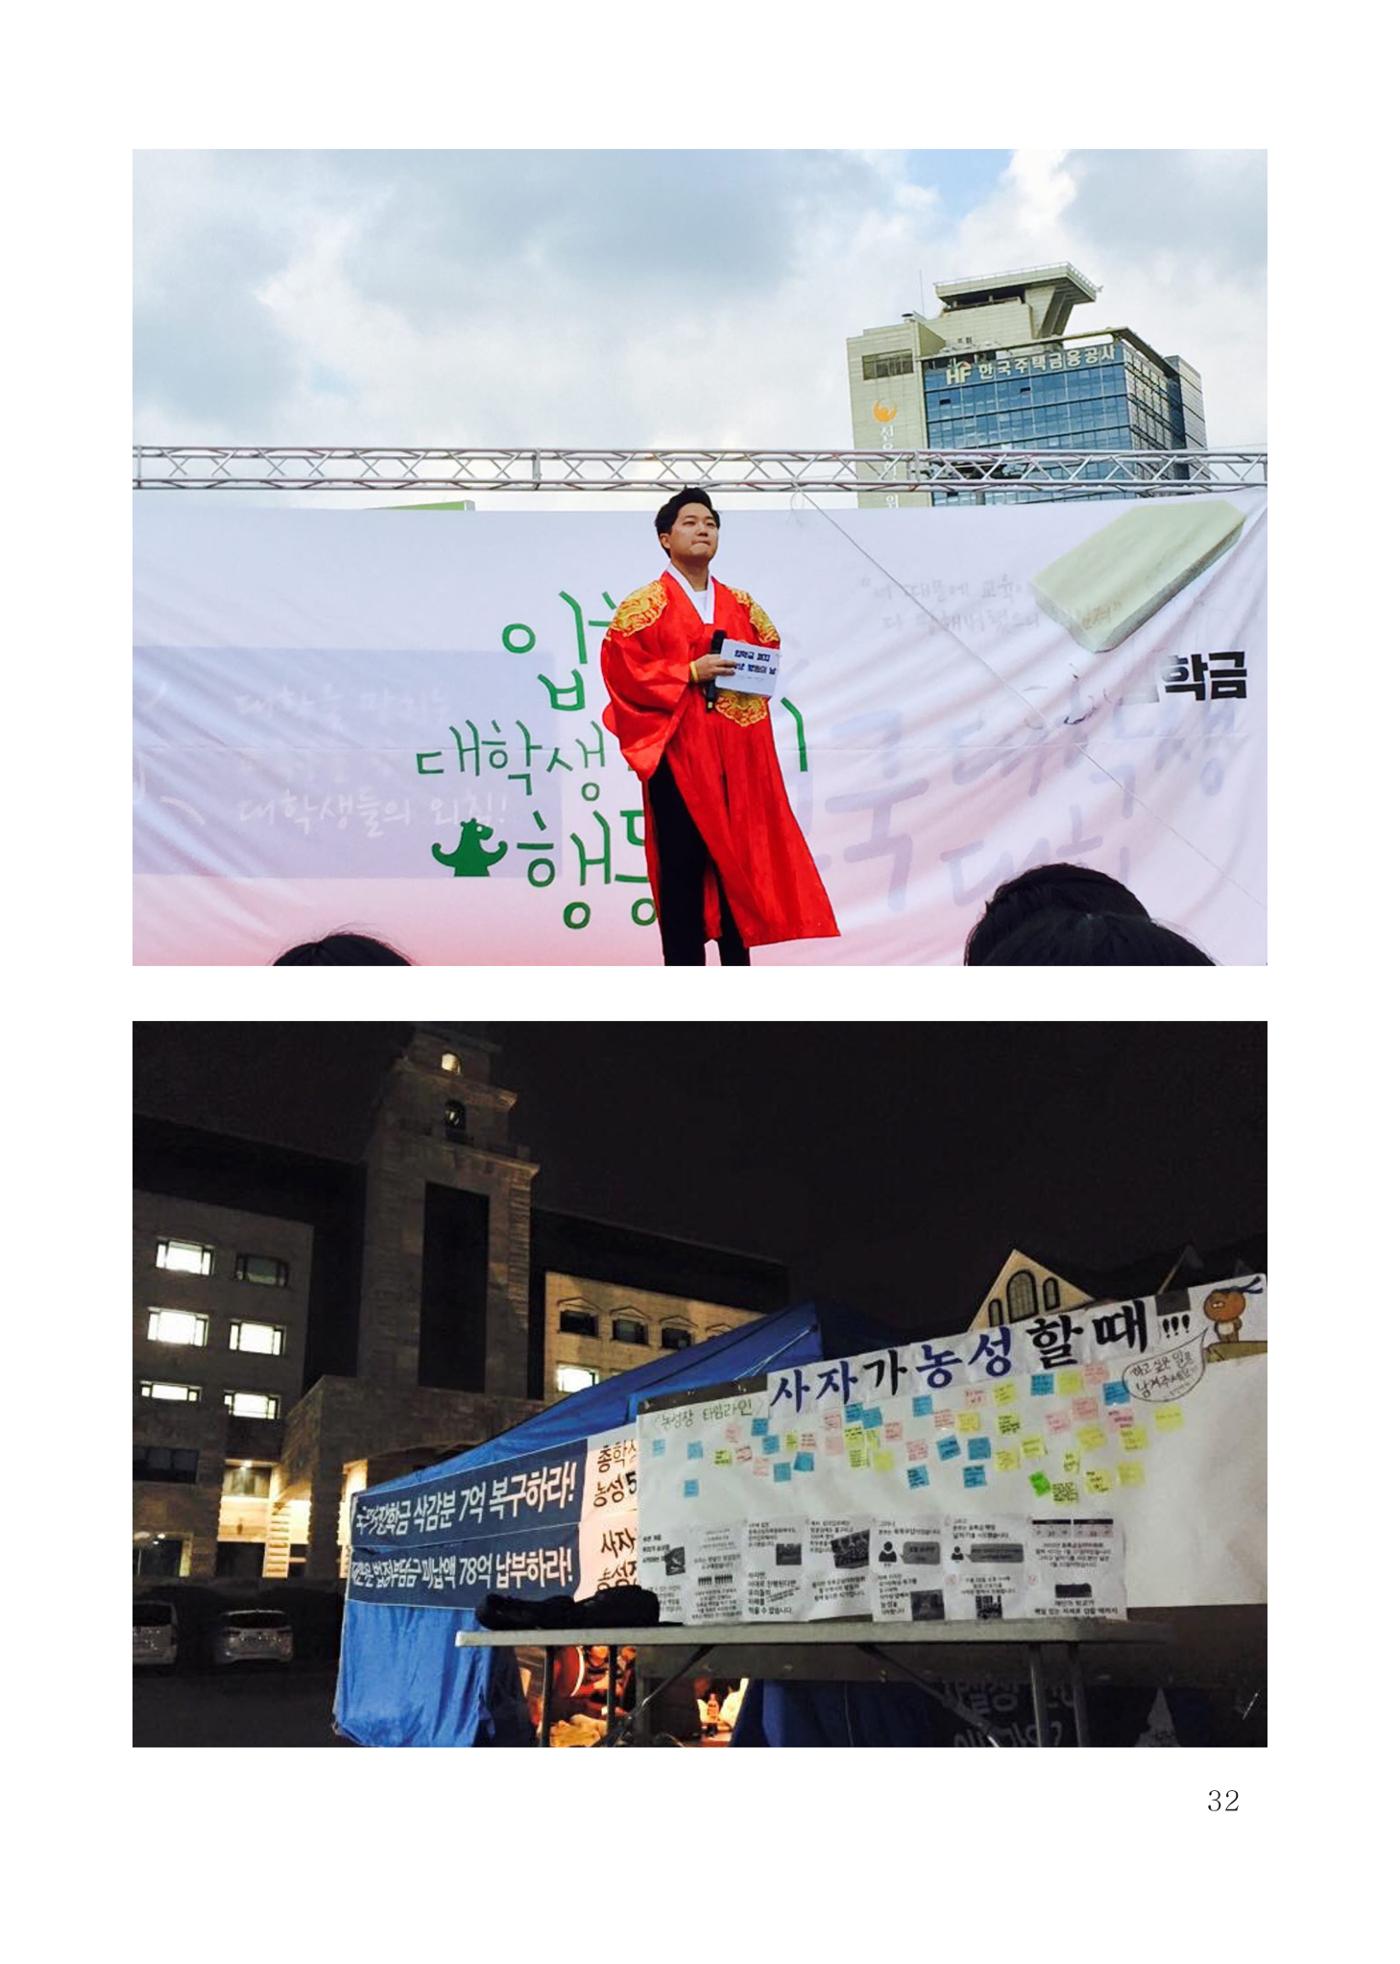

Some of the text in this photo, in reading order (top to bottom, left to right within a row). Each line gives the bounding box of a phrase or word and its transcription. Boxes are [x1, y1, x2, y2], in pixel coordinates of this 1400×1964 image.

[946, 344, 1115, 385] HF 한국주택금융공사
[416, 720, 606, 801] 대학생
[238, 785, 411, 838] 대학생들의
[770, 1348, 907, 1412] 사자가
[414, 1491, 456, 1533] 삭감분
[459, 1481, 486, 1524] 7억
[490, 1461, 577, 1520] 복구하라!
[593, 1472, 625, 1508] 농성
[373, 1555, 422, 1589] 법정부담금
[422, 1553, 456, 1590] 미납액
[459, 1551, 492, 1589] 78억
[496, 1546, 574, 1589] 납부하라!
[1207, 1789, 1240, 1812] 32
